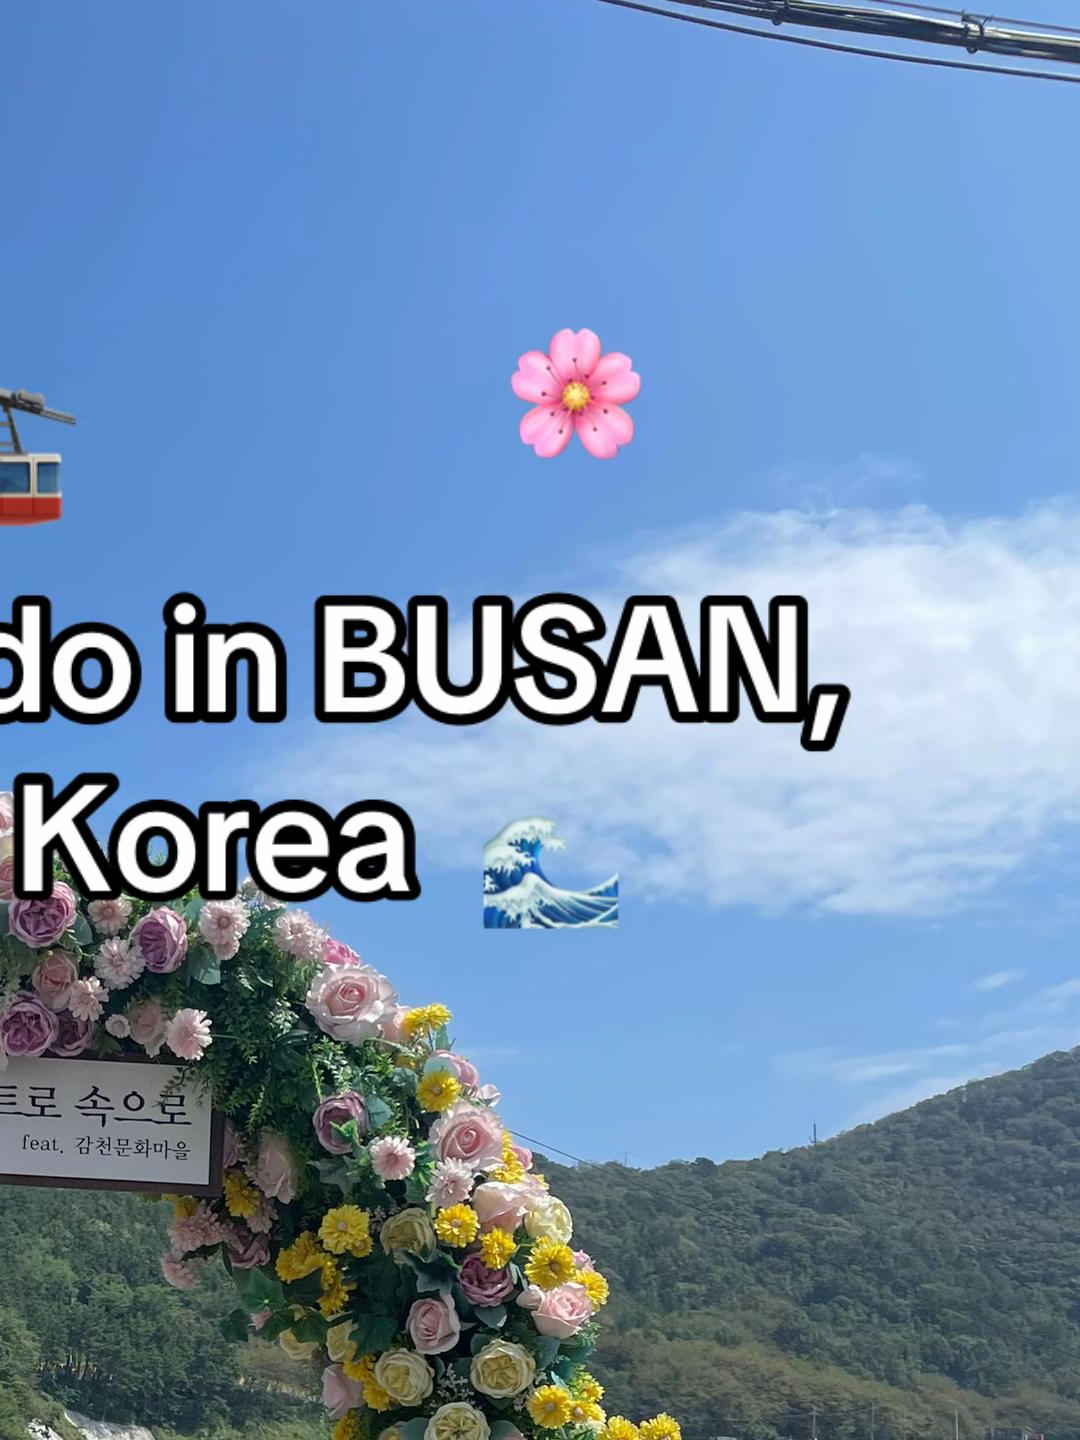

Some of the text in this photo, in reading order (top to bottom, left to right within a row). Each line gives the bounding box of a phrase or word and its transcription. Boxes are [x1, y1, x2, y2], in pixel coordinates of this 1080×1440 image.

[74, 1085, 193, 1128] 속으로
[21, 1134, 192, 1161] feat. 감천문화마을
